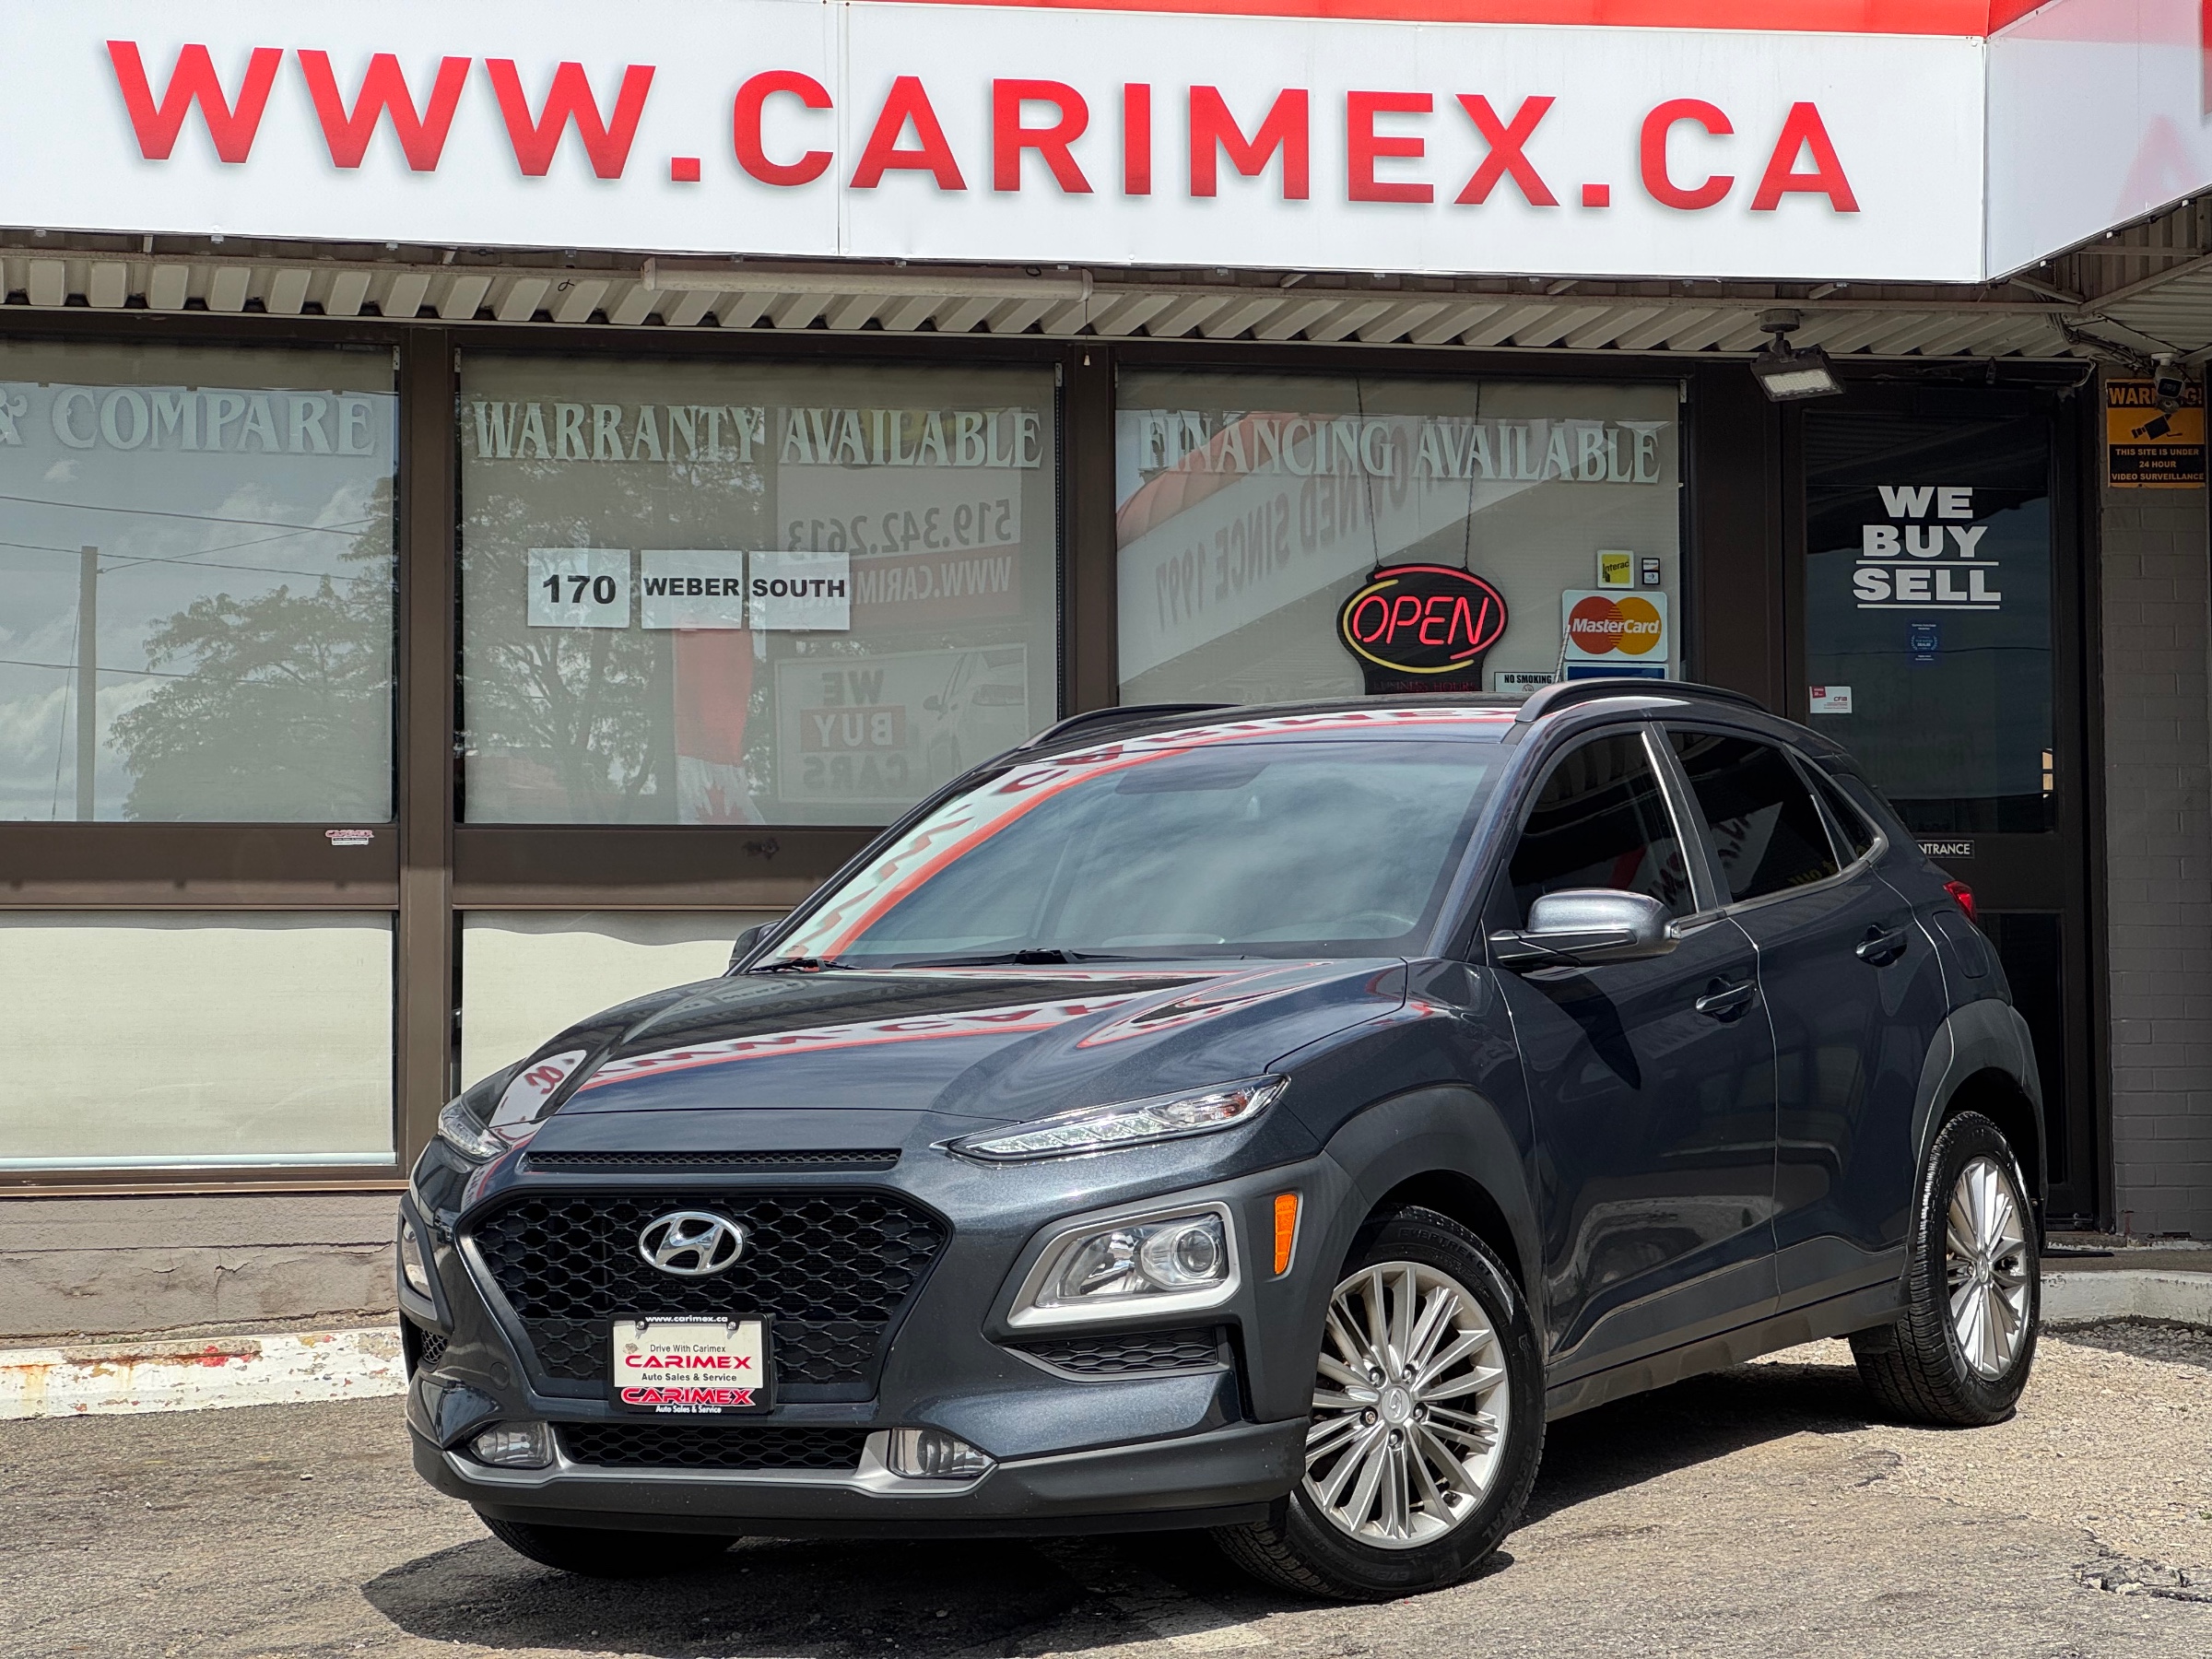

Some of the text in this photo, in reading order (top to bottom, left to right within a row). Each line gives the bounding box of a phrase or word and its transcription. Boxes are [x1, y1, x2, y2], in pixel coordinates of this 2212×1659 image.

[106, 40, 1861, 214] WWW.CARIMEX.CA
[2109, 387, 2203, 405] WARG!
[52, 386, 376, 456] COMPARE
[472, 401, 1045, 468] WARRANTY AVAILABLE
[1139, 415, 1661, 485] FINANCING AVAILABLE
[2115, 448, 2199, 456] THIS SITE IS UNDER
[1877, 486, 1973, 519] WE
[1863, 524, 1988, 558] BUY
[1603, 560, 1630, 575] Interac
[542, 574, 617, 605] 170
[643, 577, 740, 597] WEBER
[751, 579, 846, 599] SOUTH
[1853, 568, 2002, 602] SELL
[1353, 595, 1490, 645] OPEN
[1572, 618, 1660, 634] MasterCard
[1504, 675, 1552, 685] NO SMOKING
[1918, 843, 1971, 854] NTRANCE
[645, 1314, 728, 1323] www.carimex.ca
[650, 1345, 726, 1353] Drive With Carimex
[625, 1355, 752, 1370] CARIMEX
[641, 1372, 737, 1382] Auto Sales & Service
[621, 1387, 756, 1406] CARIMEX
[655, 1405, 672, 1413] Auto
[698, 1406, 722, 1414] Service
